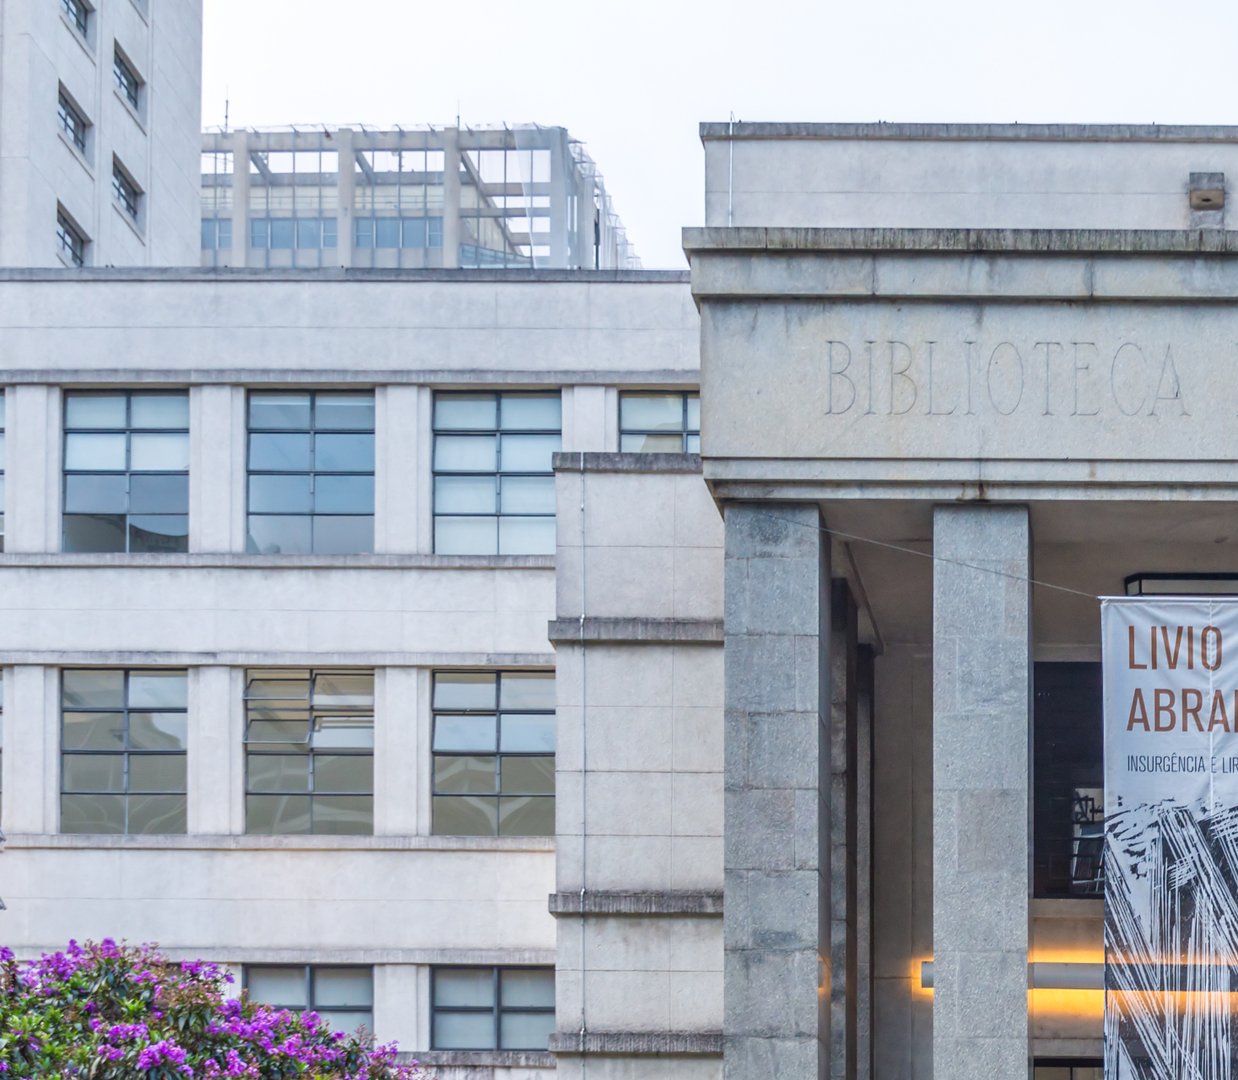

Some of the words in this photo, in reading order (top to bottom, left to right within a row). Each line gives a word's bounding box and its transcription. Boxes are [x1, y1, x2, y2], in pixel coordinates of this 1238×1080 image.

[825, 339, 1191, 418] BIBLIOTECA
[1128, 625, 1222, 671] LIVIO
[1127, 752, 1205, 773] INSURGÊNCIA
